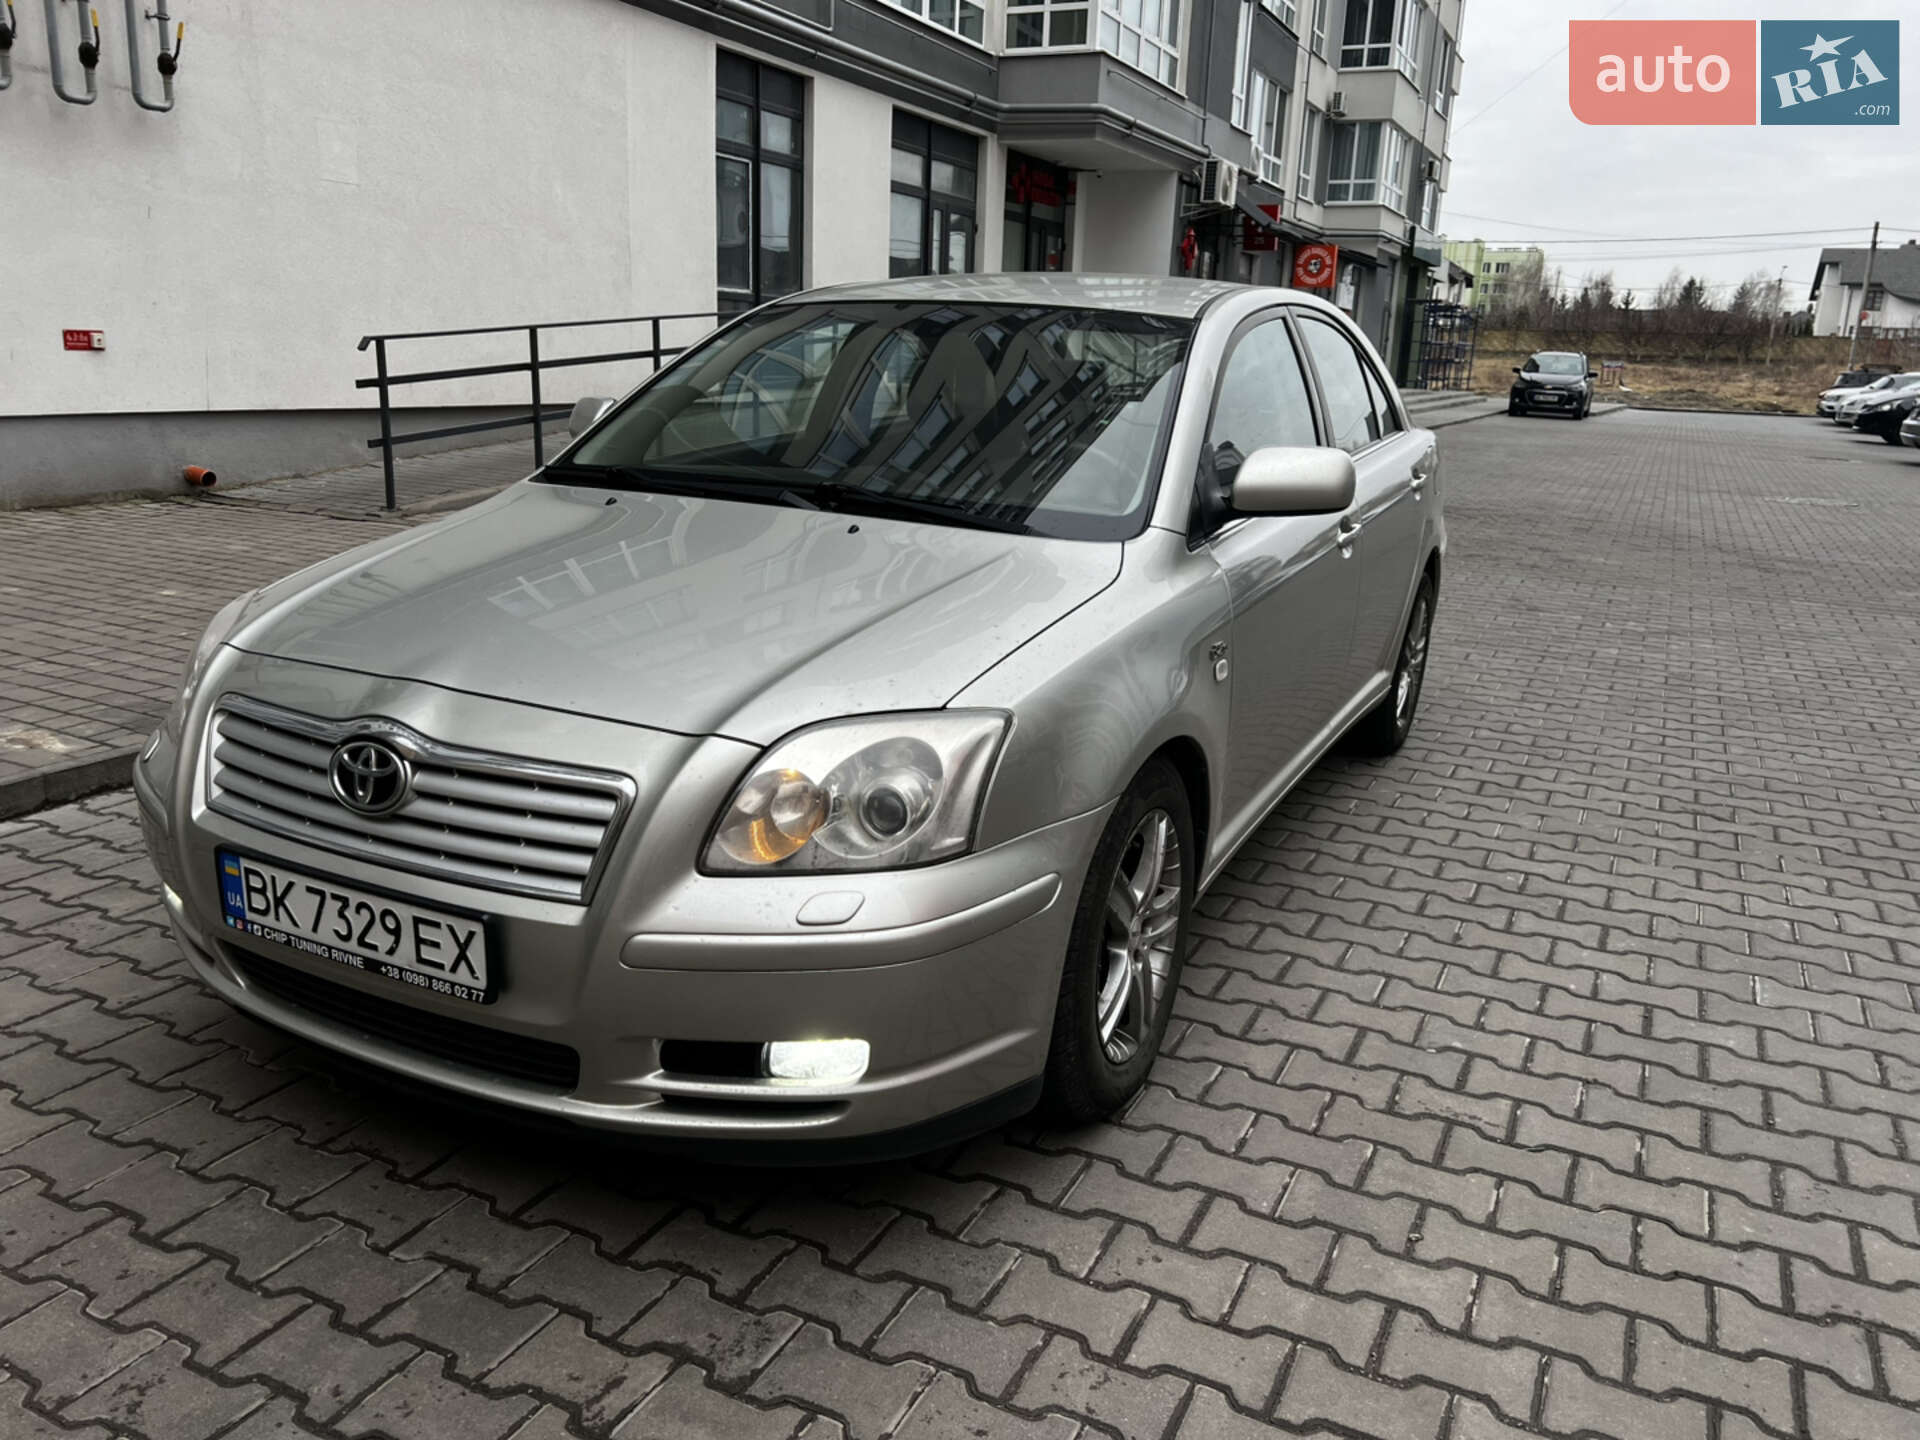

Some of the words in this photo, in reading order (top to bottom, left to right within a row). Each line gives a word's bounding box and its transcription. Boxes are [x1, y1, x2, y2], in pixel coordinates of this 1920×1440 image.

[227, 891, 244, 909] UA
[243, 865, 301, 929] BK
[306, 885, 402, 956] 7329
[412, 914, 480, 980] EX
[263, 927, 288, 944] CHIP
[289, 935, 329, 958] TUNING
[330, 949, 365, 969] RIVNE
[380, 964, 400, 980] +38
[401, 970, 430, 988] (098)
[431, 978, 452, 995] 866
[453, 984, 469, 1000] 02
[471, 989, 485, 1003] 77
